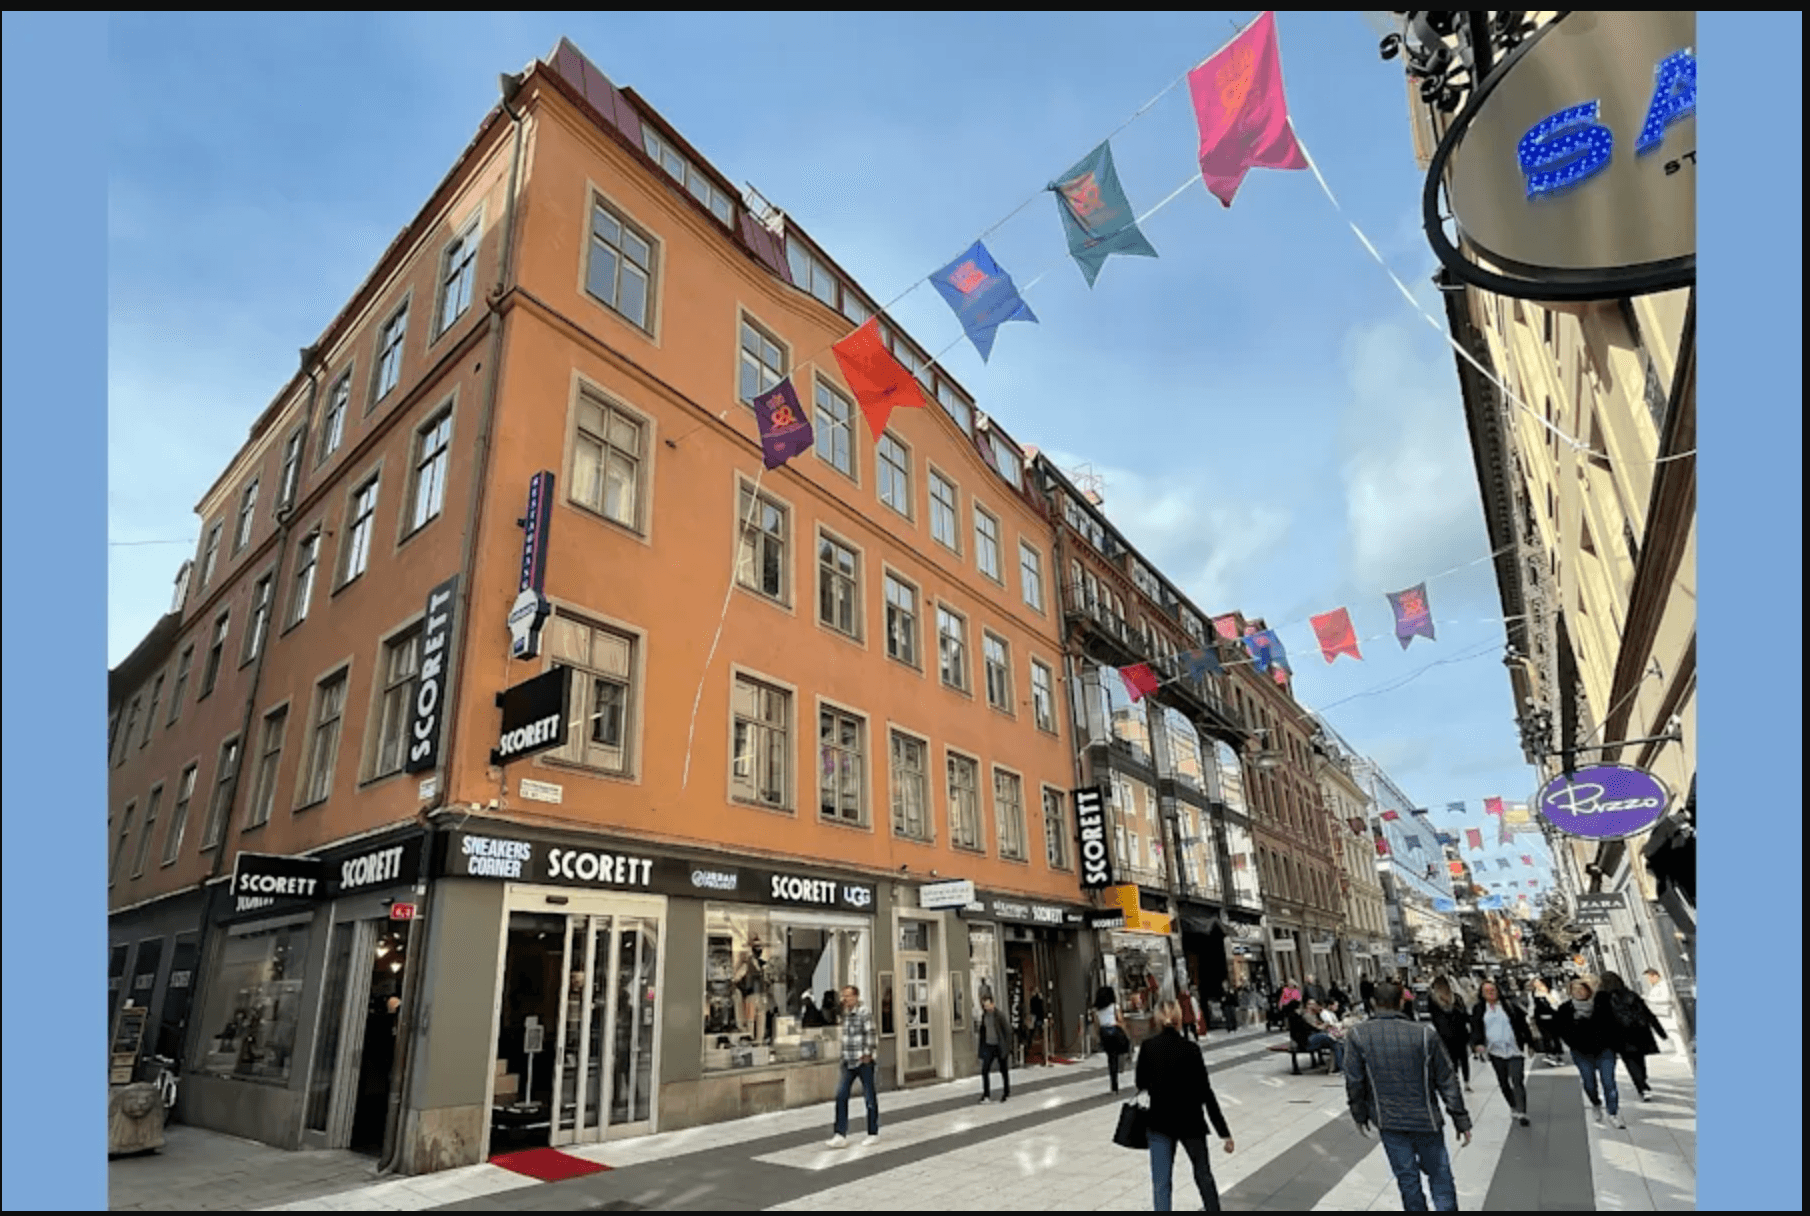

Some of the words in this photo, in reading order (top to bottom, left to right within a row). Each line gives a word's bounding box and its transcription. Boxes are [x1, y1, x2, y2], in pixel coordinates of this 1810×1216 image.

[411, 589, 450, 762] SCORETT
[500, 713, 561, 756] SCORETT
[462, 835, 531, 861] SNEAKERS
[1077, 791, 1107, 886] SCORETT
[340, 847, 403, 889] SCORETT
[468, 856, 521, 878] CORNER
[547, 848, 653, 886] SCORETT
[240, 873, 316, 895] SCORETT
[771, 875, 836, 904] SCORETT
[843, 889, 871, 907] UGG
[1580, 900, 1623, 909] ZARA
